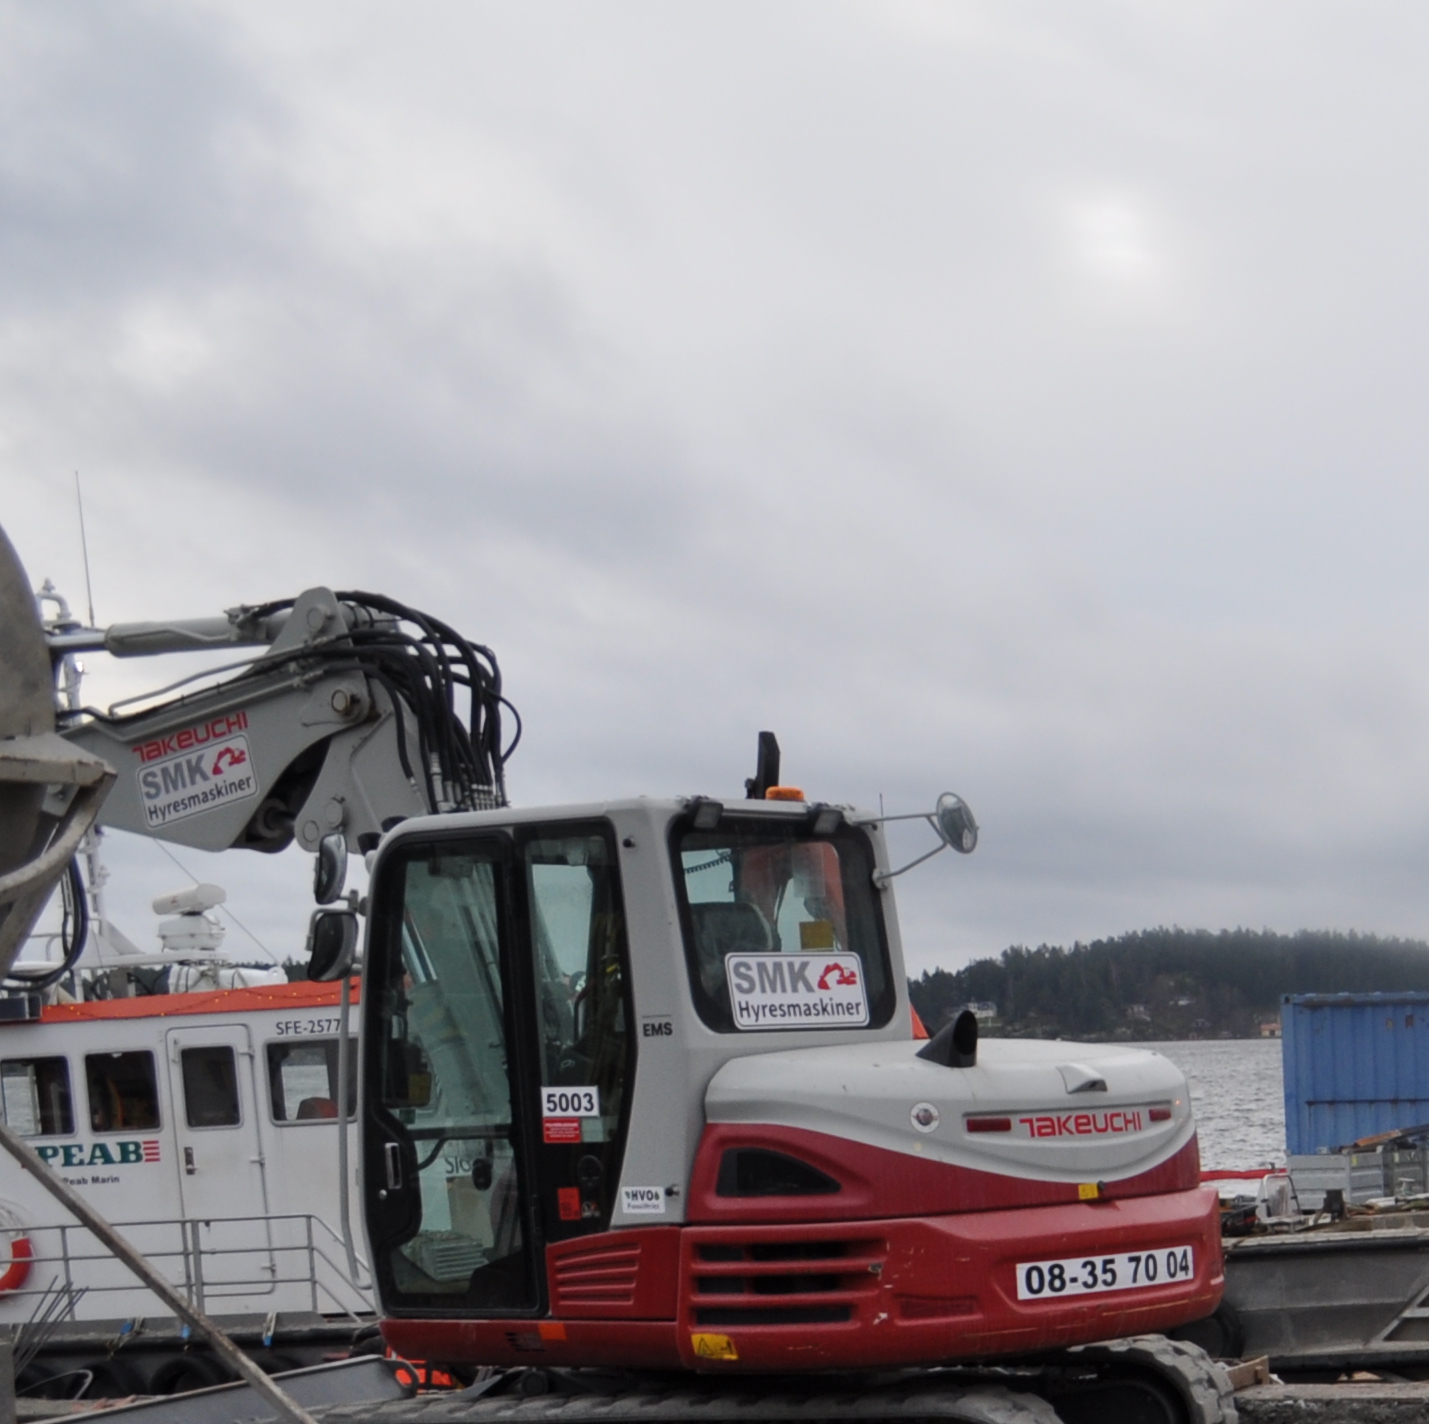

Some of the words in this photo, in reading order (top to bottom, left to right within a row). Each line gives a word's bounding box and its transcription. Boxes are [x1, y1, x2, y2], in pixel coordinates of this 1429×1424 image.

[132, 711, 249, 762] TAKEUCHI
[142, 753, 210, 800] SMK
[147, 776, 252, 821] Hyresmaskiner
[732, 961, 815, 994] SMK
[738, 997, 862, 1022] Hyresmaskiner
[275, 1018, 341, 1035] SFE-2577
[642, 1022, 673, 1037] EMS
[546, 1092, 594, 1112] 5003
[1019, 1111, 1142, 1138] TAKEUCHI
[34, 1141, 143, 1167] PEAB
[91, 1174, 120, 1185] Marin
[631, 1189, 654, 1201] HVO
[1025, 1260, 1118, 1296] 08-35
[1128, 1252, 1158, 1284] 70
[1166, 1248, 1190, 1280] 04
